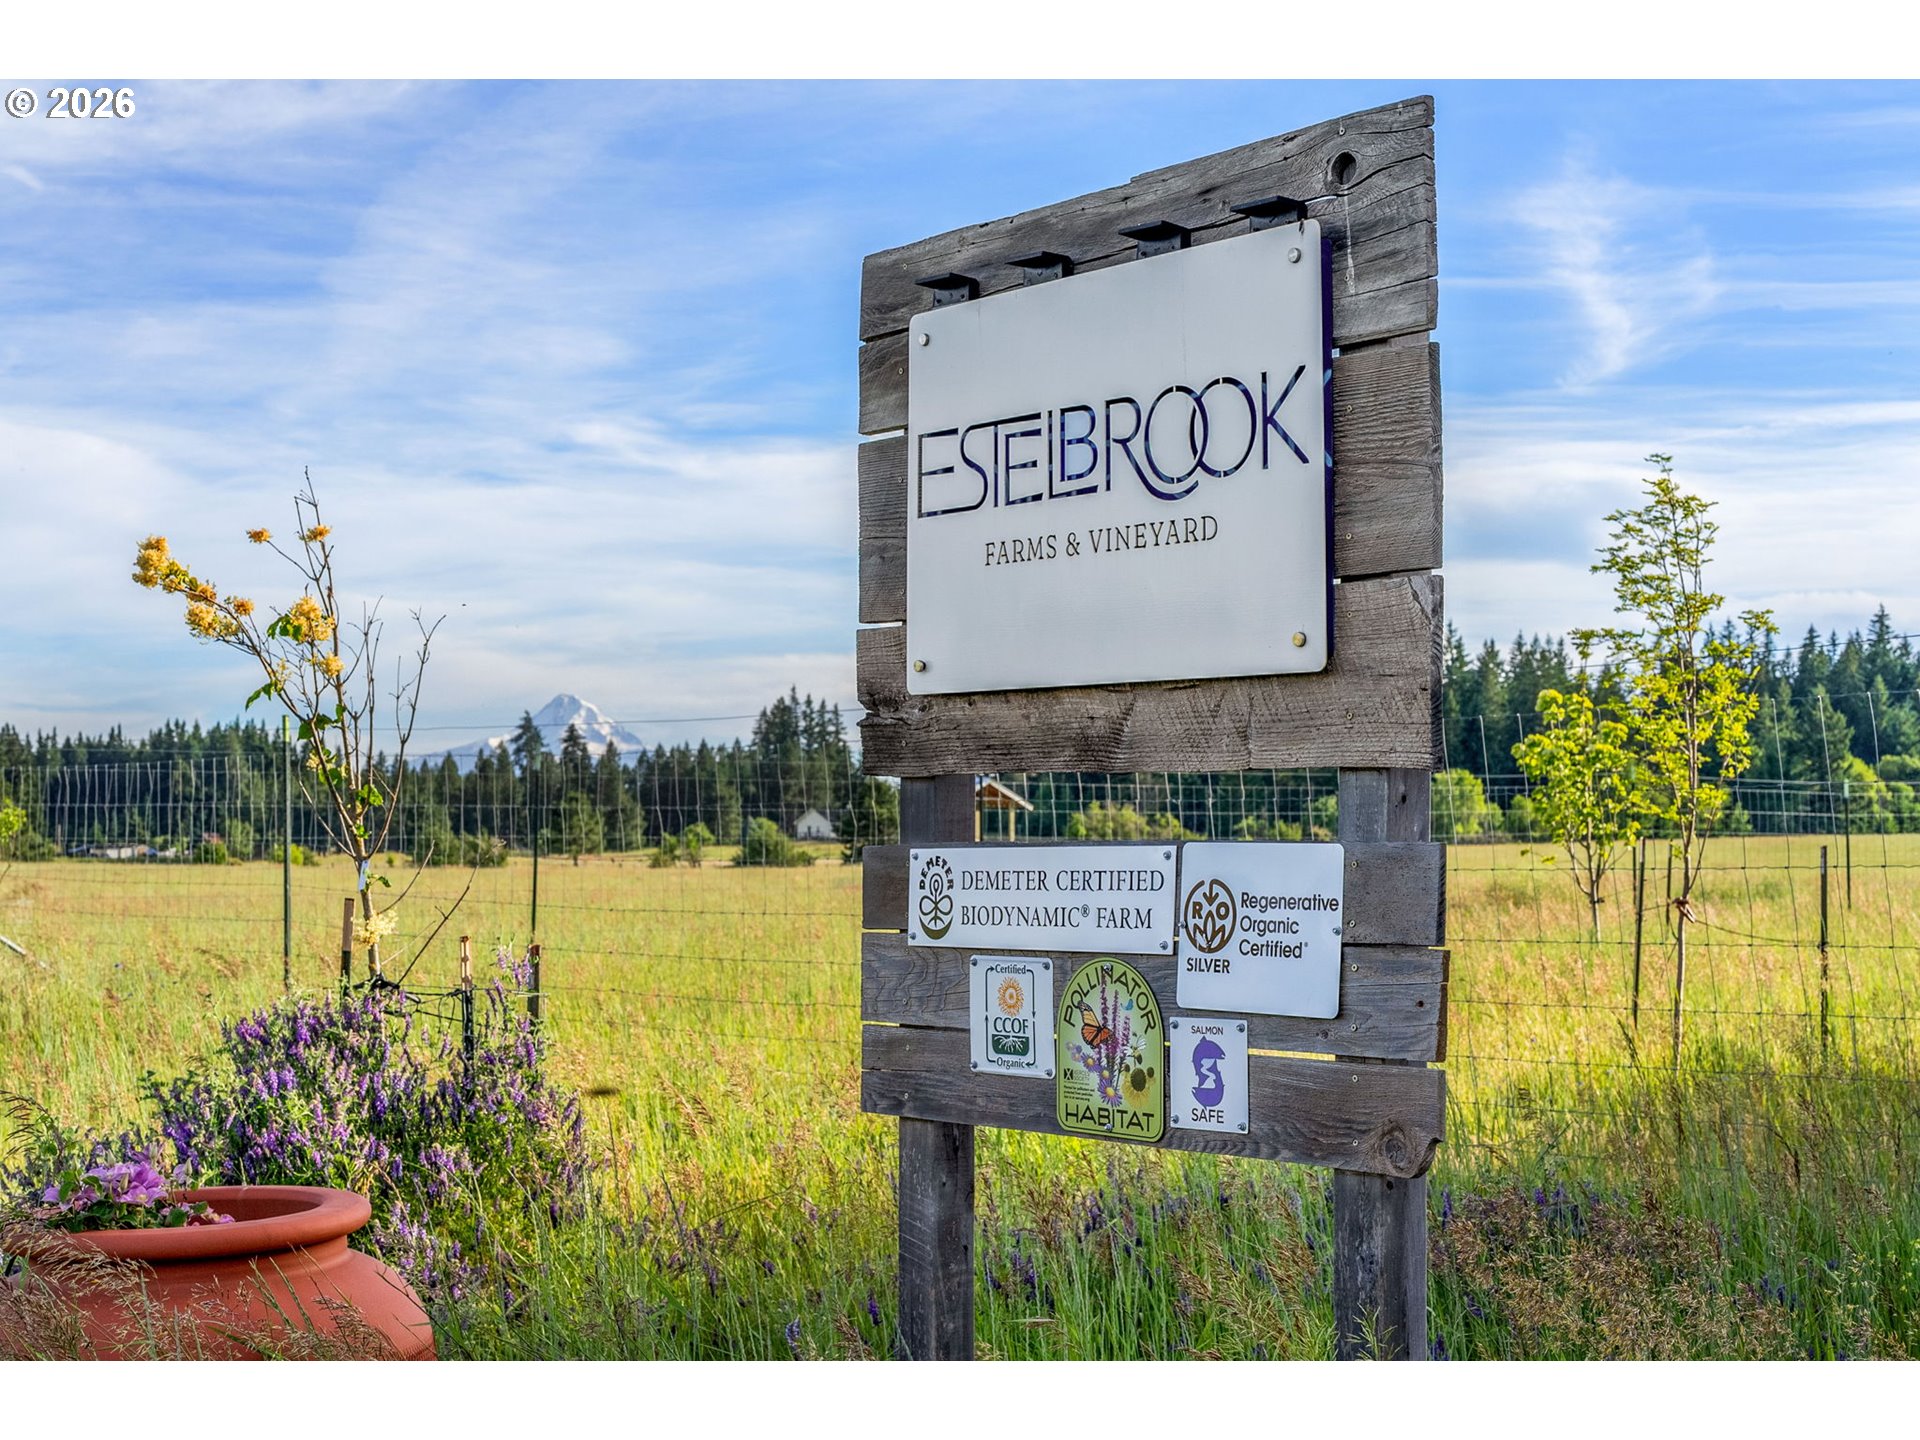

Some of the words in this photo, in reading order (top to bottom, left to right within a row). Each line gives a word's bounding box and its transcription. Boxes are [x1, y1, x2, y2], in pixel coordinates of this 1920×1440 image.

[918, 365, 1309, 518] ESTELBROOK
[985, 535, 1057, 566] FARMS
[1066, 532, 1081, 557] &
[1088, 515, 1219, 553] VINEYARD
[919, 855, 954, 891] DEMETER
[961, 870, 1049, 891] DEMETER
[1056, 870, 1164, 892] CERTIFIED
[1240, 891, 1339, 913] Regenerative
[1096, 907, 1153, 929] FARM
[1239, 915, 1299, 937] Organic
[1239, 939, 1308, 959] Certified
[994, 963, 1027, 975] Certified
[1186, 957, 1231, 974] SILVER
[1063, 964, 1157, 1035] POLLINATOR
[993, 1016, 1029, 1034] CCOF
[1190, 1025, 1224, 1036] SALMON
[996, 1056, 1026, 1069] Organic
[1065, 1102, 1155, 1132] HABITAT
[1191, 1107, 1225, 1124] SAFE
